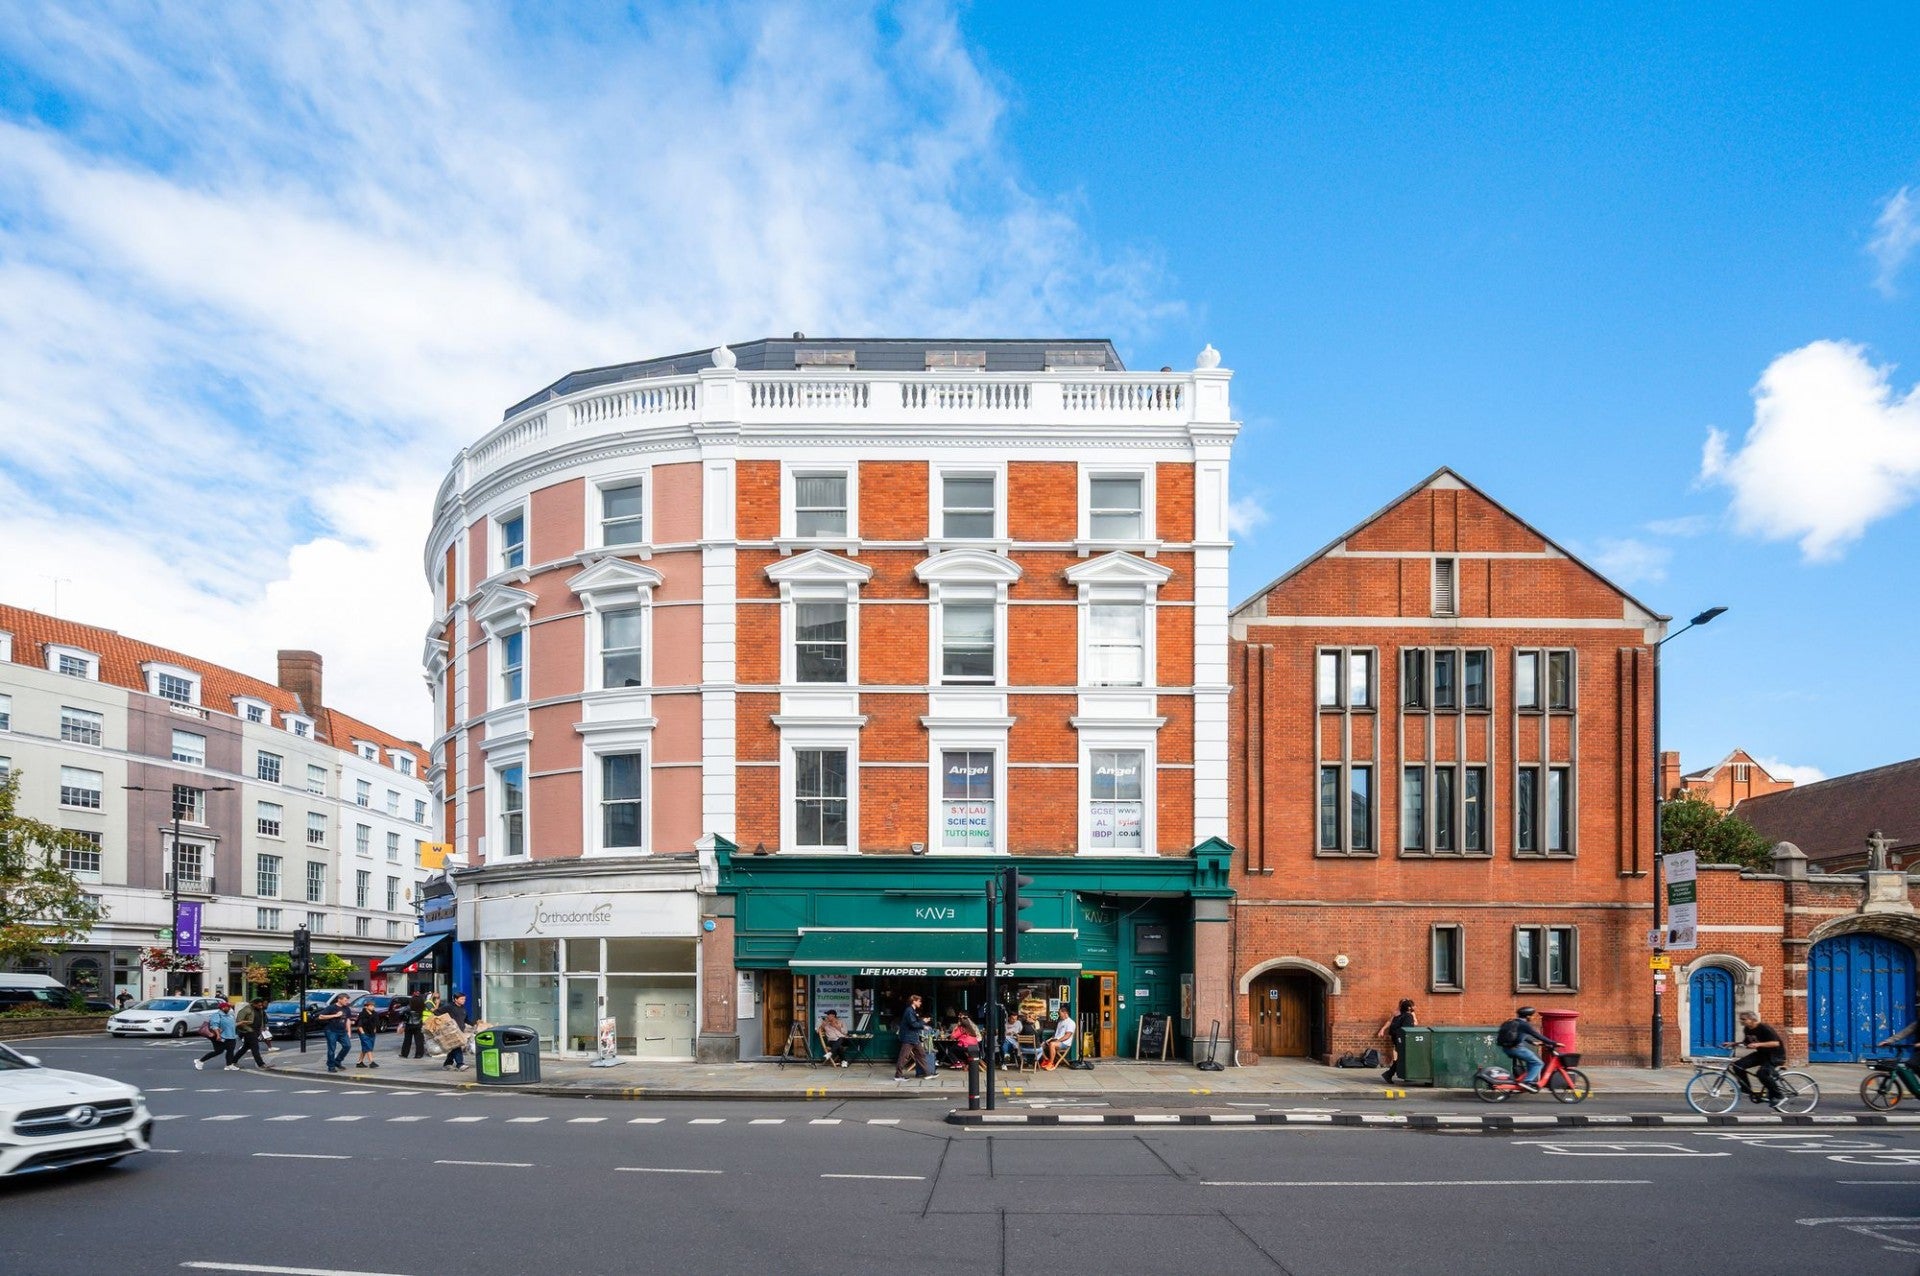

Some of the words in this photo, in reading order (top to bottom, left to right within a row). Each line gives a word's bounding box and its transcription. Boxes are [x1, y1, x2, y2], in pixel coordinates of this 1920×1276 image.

[949, 766, 989, 776] Angel
[1096, 766, 1137, 776] Angel
[945, 829, 990, 837] TUTORING
[1092, 830, 1113, 838] IBDP
[539, 910, 612, 924] Orthodontiste
[860, 968, 881, 976] LIFE
[882, 968, 928, 976] HAPPENS
[944, 968, 982, 977] COFFEE
[983, 968, 1015, 977] LPS
